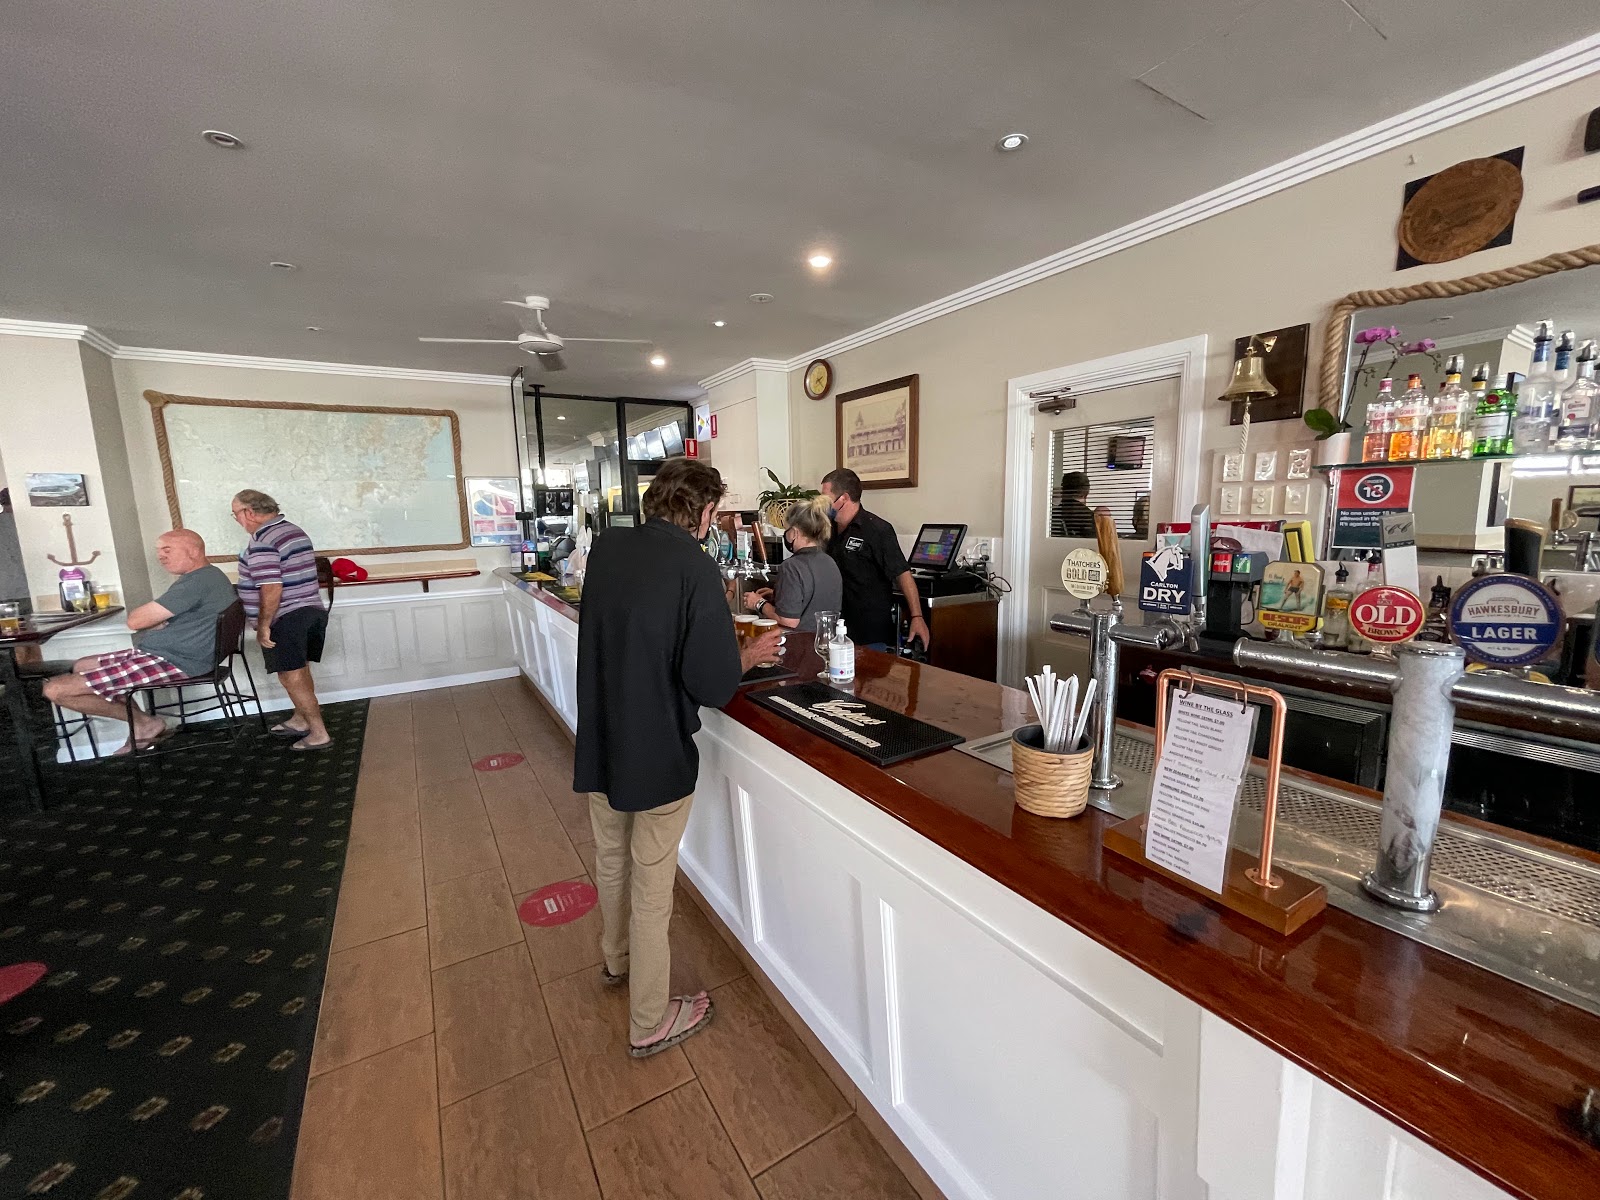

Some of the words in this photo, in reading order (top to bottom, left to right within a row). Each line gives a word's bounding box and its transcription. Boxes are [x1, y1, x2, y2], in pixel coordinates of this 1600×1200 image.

[1363, 484, 1384, 498] 18
[1067, 559, 1100, 568] THATCHERS
[1066, 568, 1087, 580] GOLD
[1144, 586, 1186, 603] DRY
[1356, 604, 1416, 625] OLD
[1468, 604, 1540, 616] HAWKESBURY
[1368, 627, 1400, 636] BROWN
[1472, 626, 1537, 640] LAGER
[1216, 708, 1233, 717] GLASS
